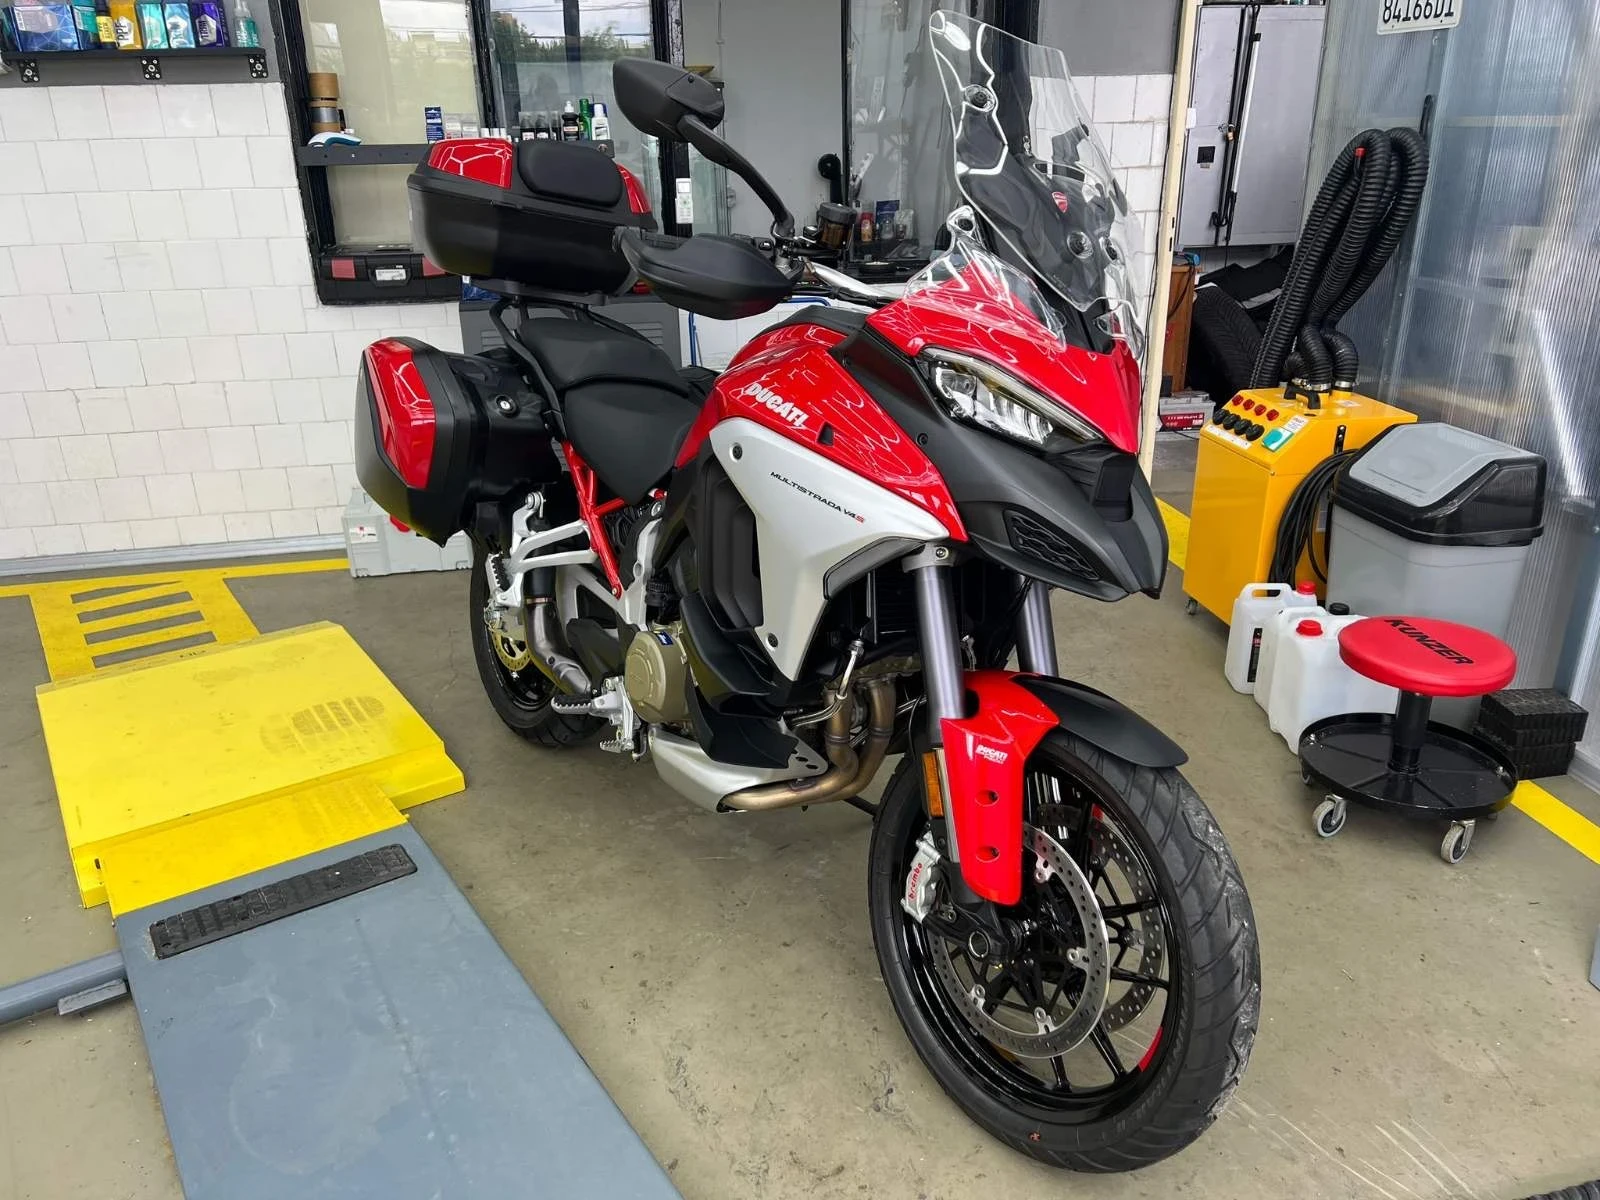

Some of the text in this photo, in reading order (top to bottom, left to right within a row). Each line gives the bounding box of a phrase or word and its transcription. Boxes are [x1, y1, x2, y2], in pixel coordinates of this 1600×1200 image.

[748, 382, 810, 427] DUCATI
[770, 471, 842, 512] MULTISTRADA
[1383, 619, 1474, 664] KUNZER
[908, 862, 923, 899] brembo
